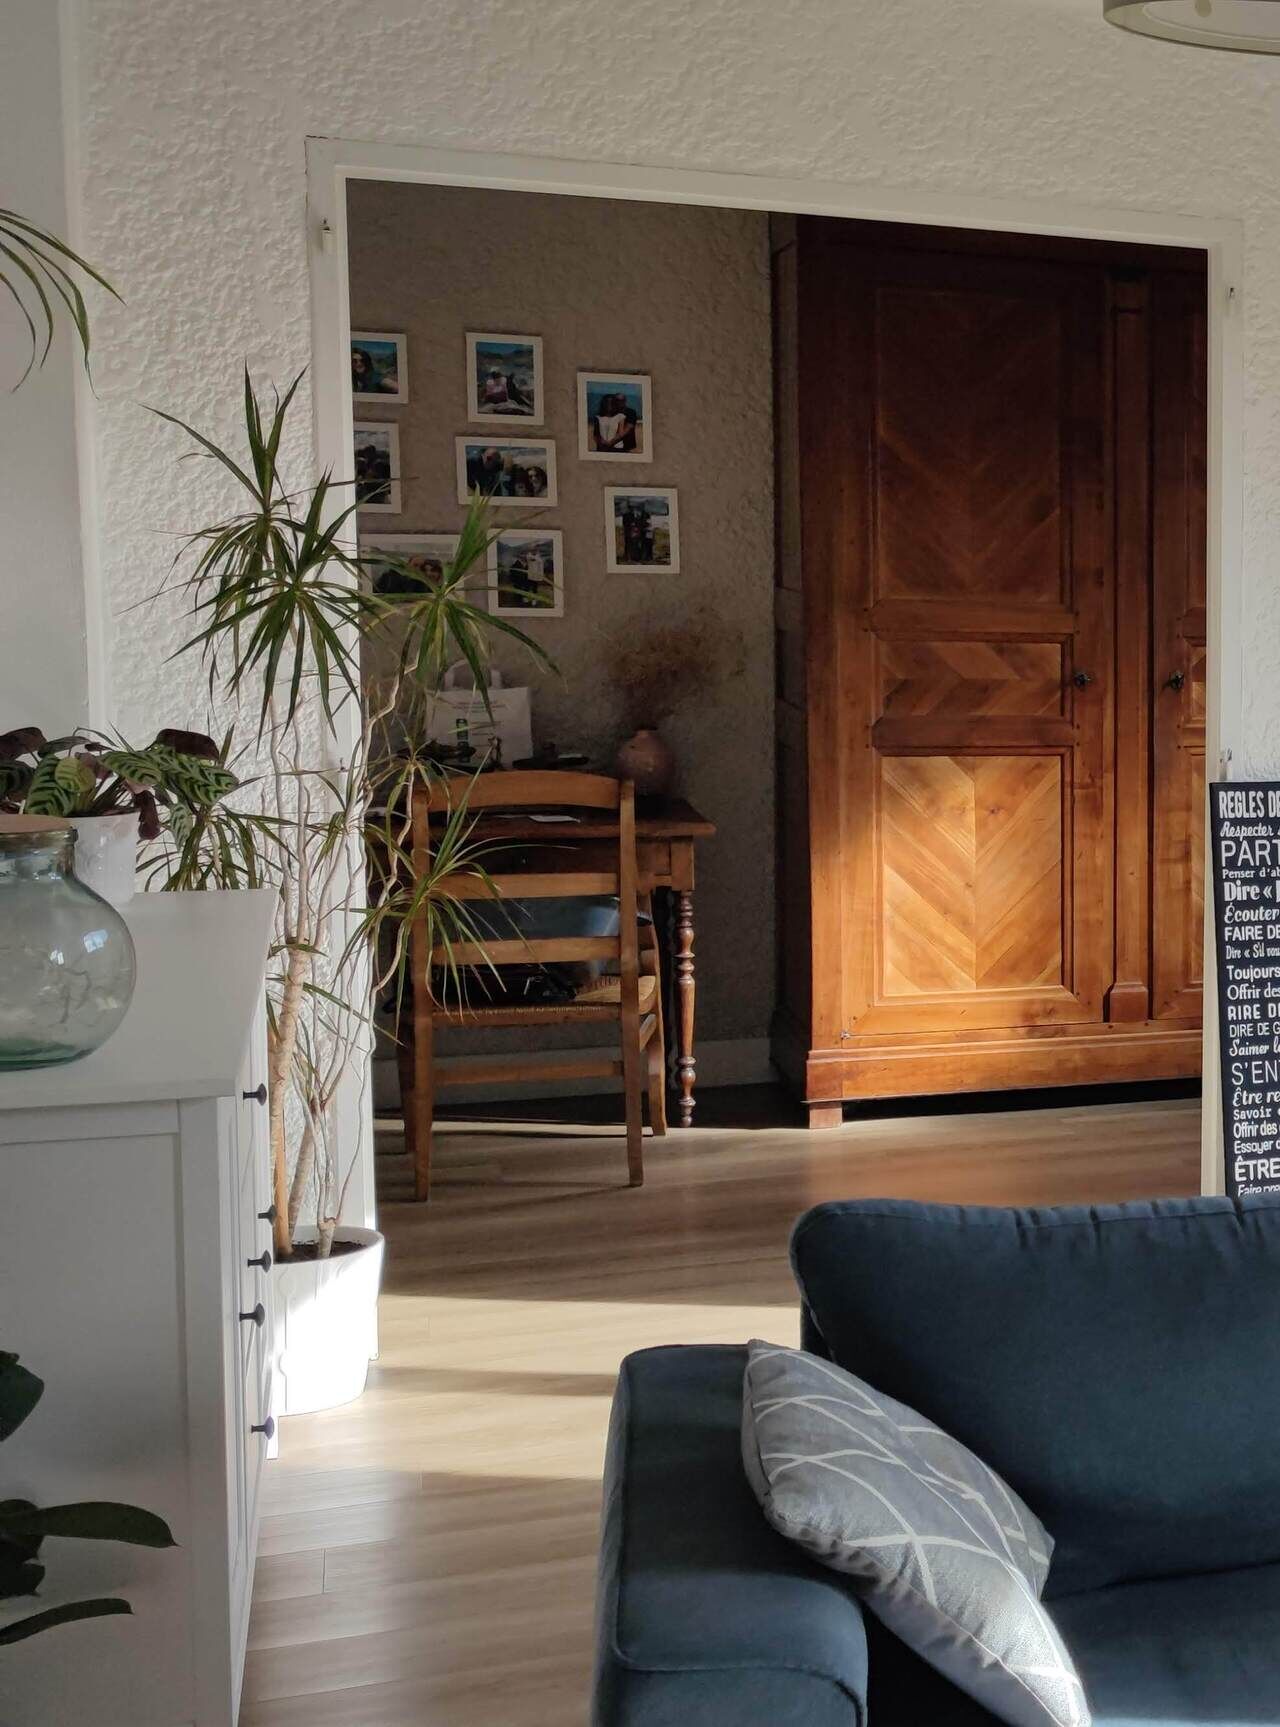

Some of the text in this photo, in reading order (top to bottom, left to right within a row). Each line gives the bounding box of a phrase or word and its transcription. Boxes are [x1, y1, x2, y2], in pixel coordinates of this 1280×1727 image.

[1219, 791, 1264, 819] REGLES
[1220, 821, 1274, 842] Respecter
[1222, 868, 1255, 879] Penser
[1224, 879, 1260, 901] Dire
[1224, 902, 1280, 924] Écouter
[1224, 925, 1264, 941] FAIRE
[1226, 945, 1241, 960] Dire
[1226, 964, 1280, 982] Toujours
[1227, 983, 1261, 1000] Offrir
[1227, 1004, 1261, 1021] RIRE
[1229, 1023, 1254, 1038] DIRE
[1257, 1022, 1270, 1036] DE
[1232, 1086, 1263, 1107] Être
[1233, 1106, 1272, 1121] Savoir
[1233, 1121, 1259, 1139] Offrir
[1260, 1120, 1278, 1136] des
[1234, 1140, 1274, 1154] Essayer
